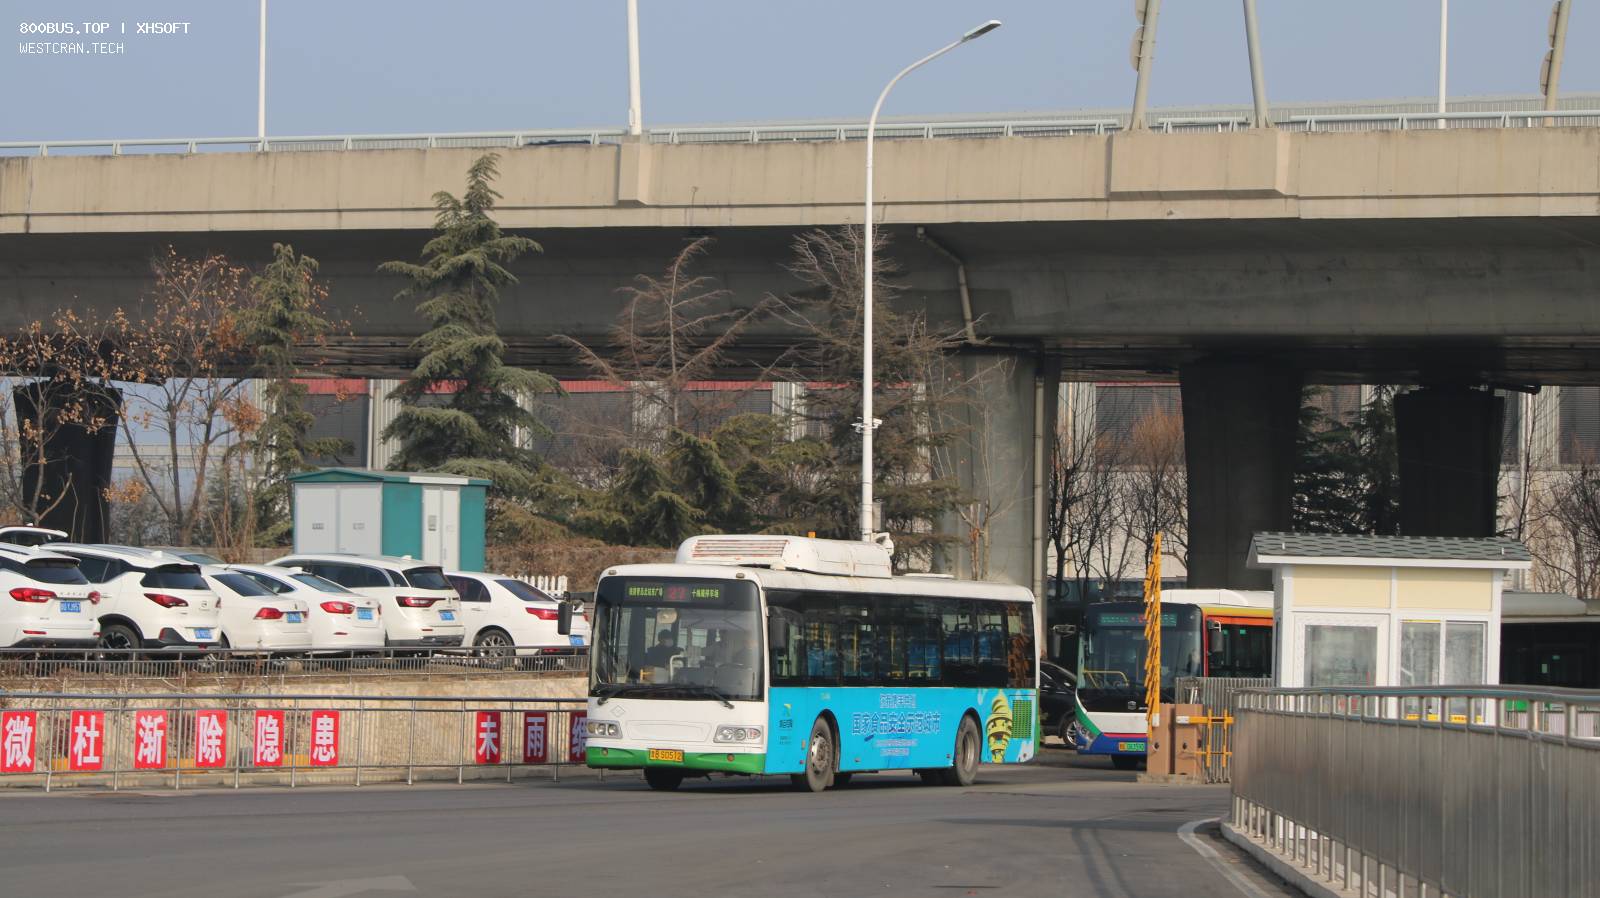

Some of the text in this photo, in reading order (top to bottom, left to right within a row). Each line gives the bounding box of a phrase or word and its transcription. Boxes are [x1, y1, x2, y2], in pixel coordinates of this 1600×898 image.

[4, 714, 335, 767] 微 杜 渐 除 隐 患
[478, 715, 499, 760] 未
[526, 716, 546, 757] 雨
[852, 711, 940, 735] 国家食品安全示范城市
